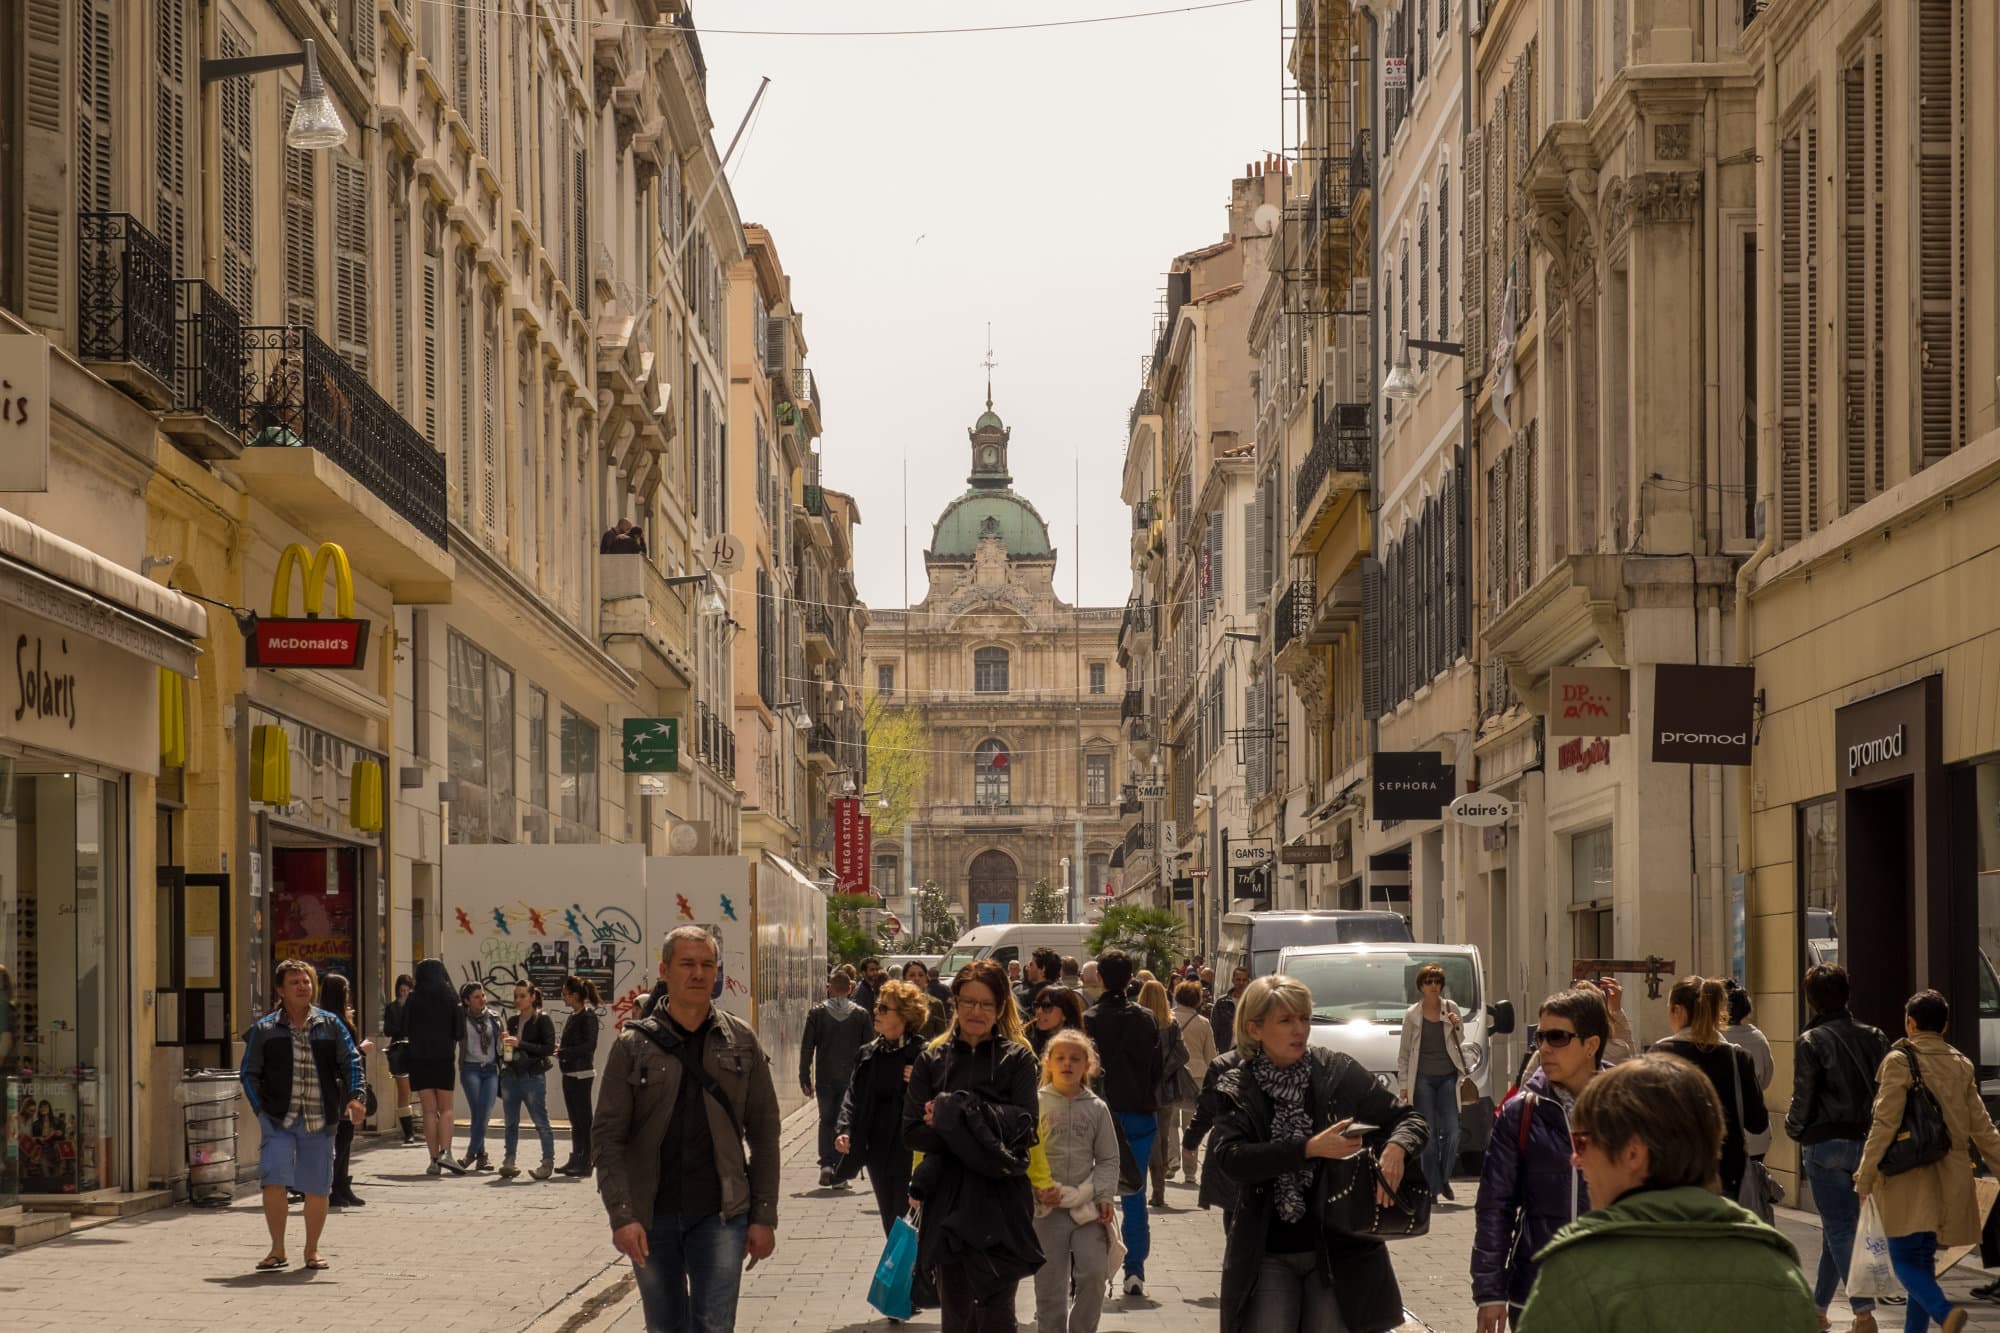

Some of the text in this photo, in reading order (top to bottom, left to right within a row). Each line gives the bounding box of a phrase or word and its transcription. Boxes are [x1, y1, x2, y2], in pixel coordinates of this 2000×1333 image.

[268, 637, 349, 650] McDonald's
[15, 633, 76, 730] Solaris
[1661, 731, 1747, 745] promod
[1848, 723, 1903, 777] promod
[1379, 781, 1437, 791] SEPHORA
[1456, 803, 1509, 816] claire's
[842, 801, 851, 874] MEGASTORE
[1235, 848, 1265, 859] GANTS
